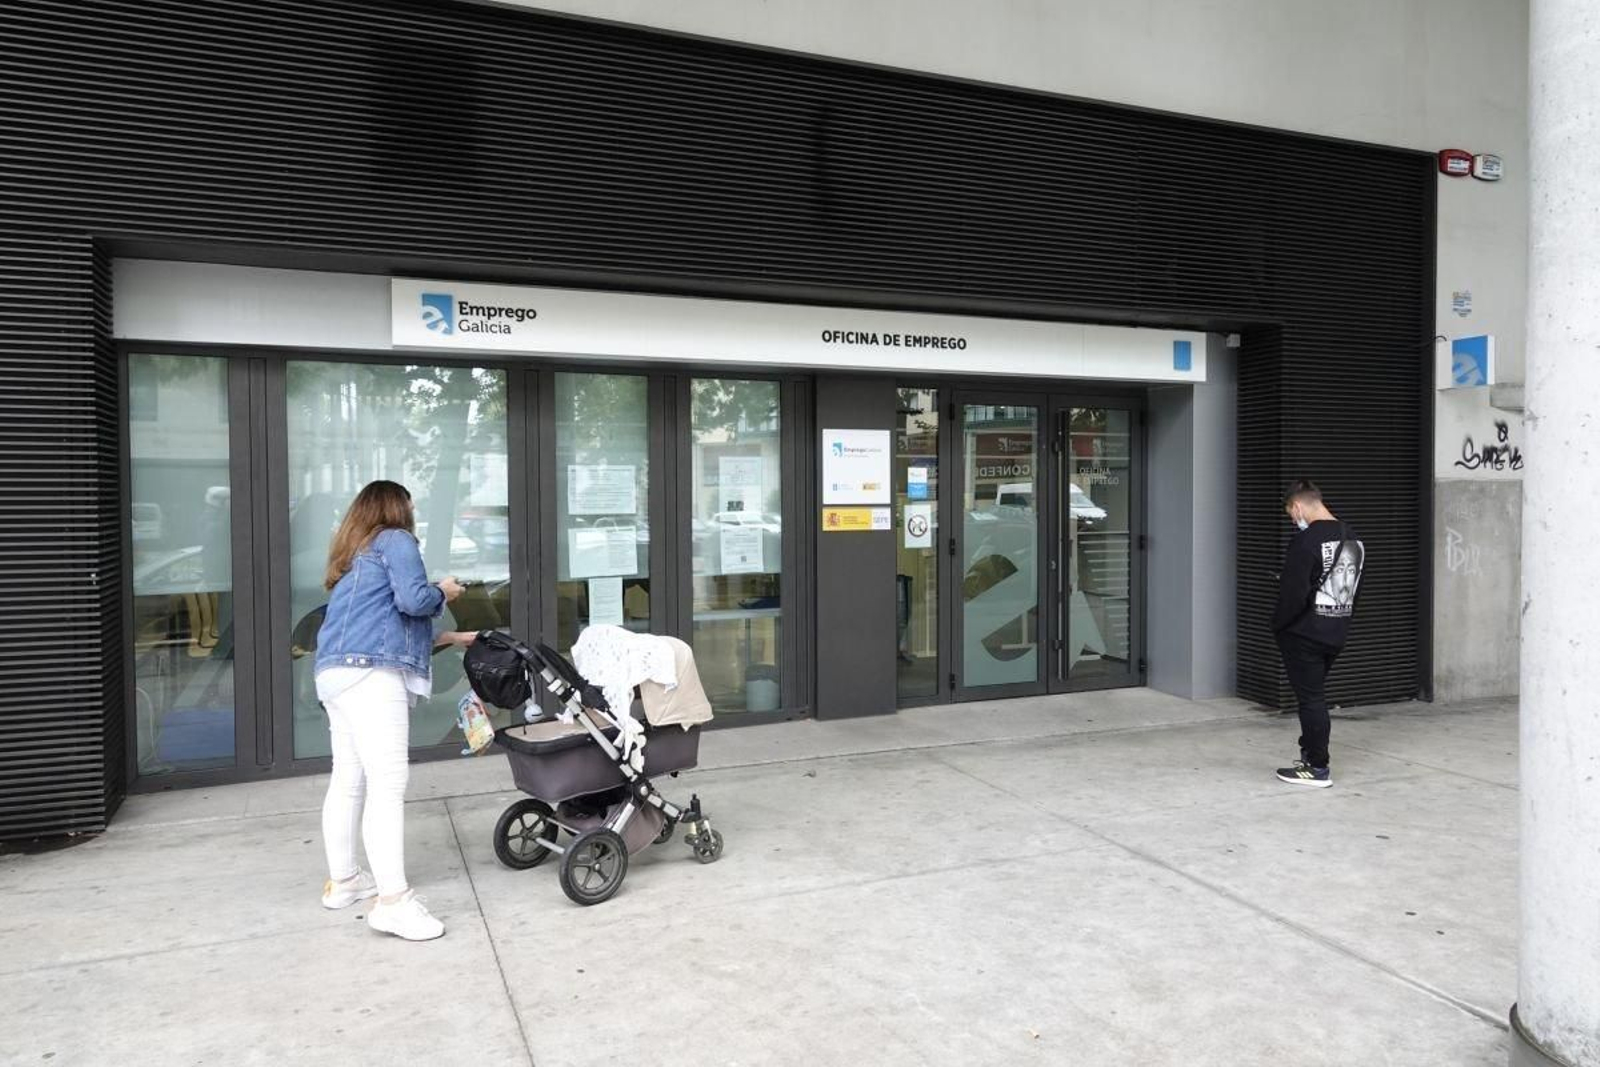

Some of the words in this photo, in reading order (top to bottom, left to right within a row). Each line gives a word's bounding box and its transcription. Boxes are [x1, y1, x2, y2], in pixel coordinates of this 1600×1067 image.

[458, 300, 537, 322] Emprego
[458, 319, 512, 334] Galicia
[821, 329, 879, 346] OFICINA
[883, 333, 901, 346] DE
[904, 334, 967, 350] EMPREGO
